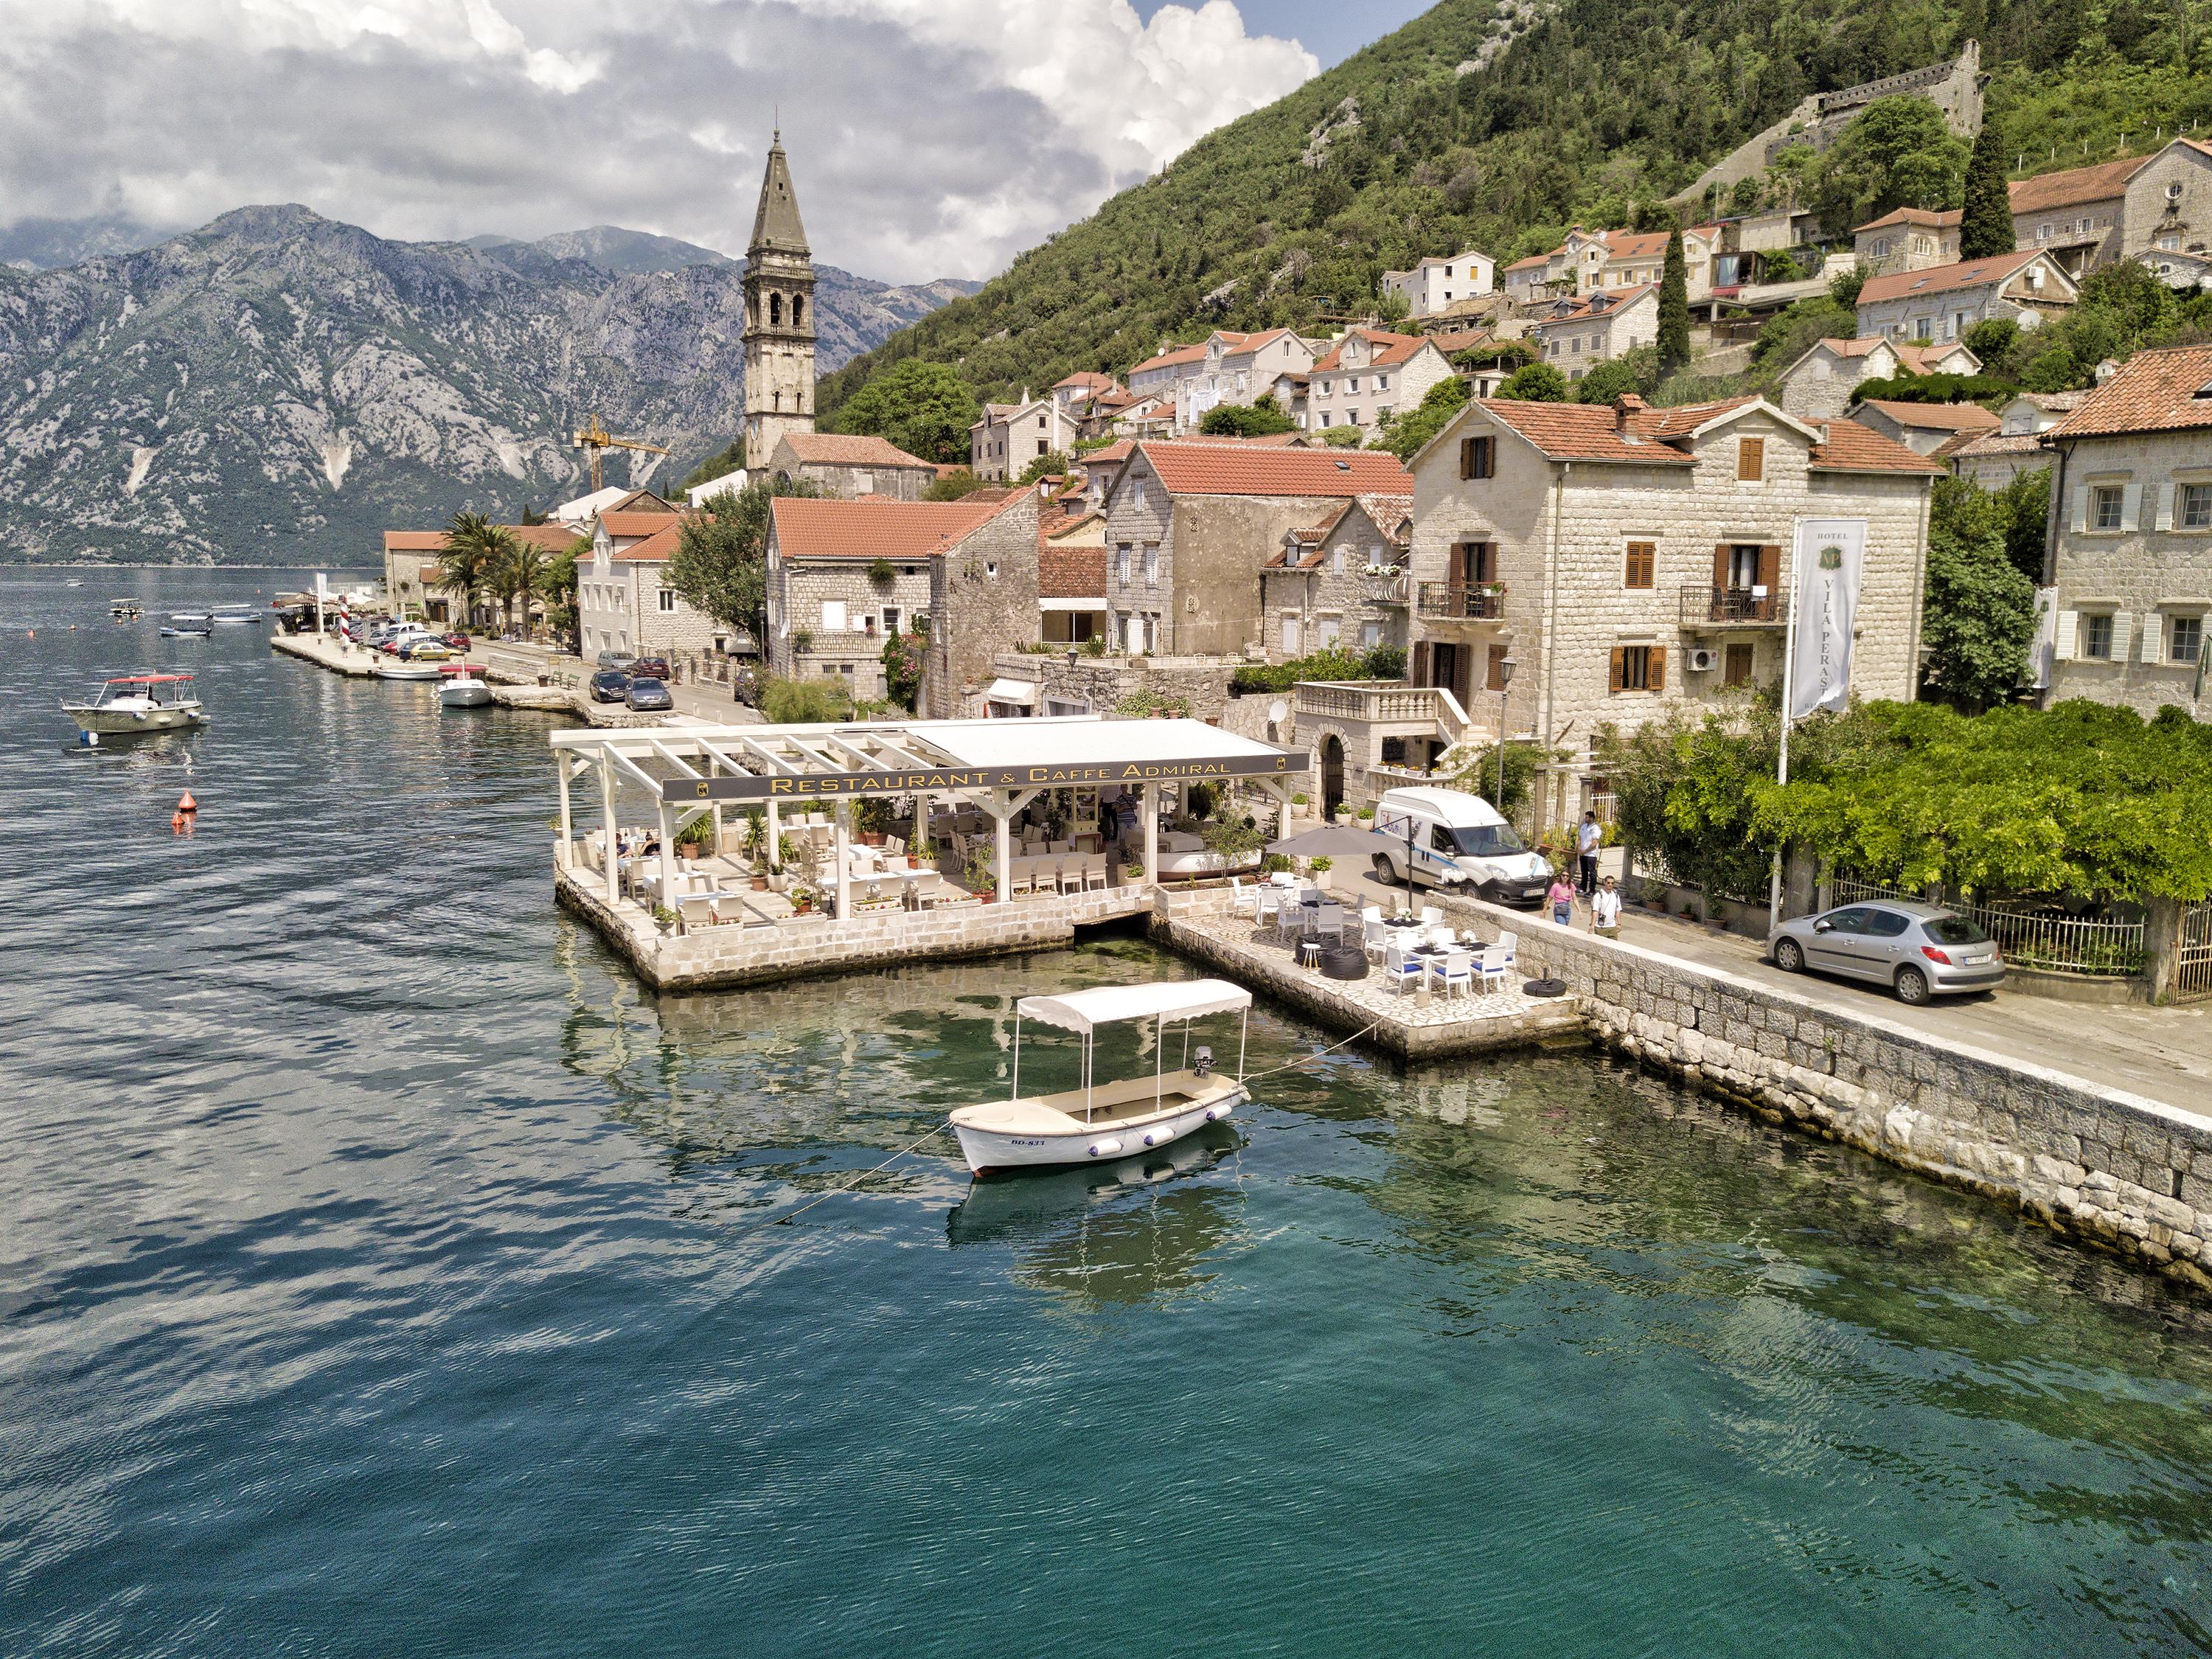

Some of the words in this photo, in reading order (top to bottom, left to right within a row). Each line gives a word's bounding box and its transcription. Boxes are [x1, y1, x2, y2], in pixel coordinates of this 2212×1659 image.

[1821, 579, 1834, 625] VILA
[771, 772, 990, 794] RESTAURANT
[1001, 773, 1015, 784] &
[1029, 768, 1111, 782] CAFFE
[1121, 763, 1231, 778] ADMIRAL
